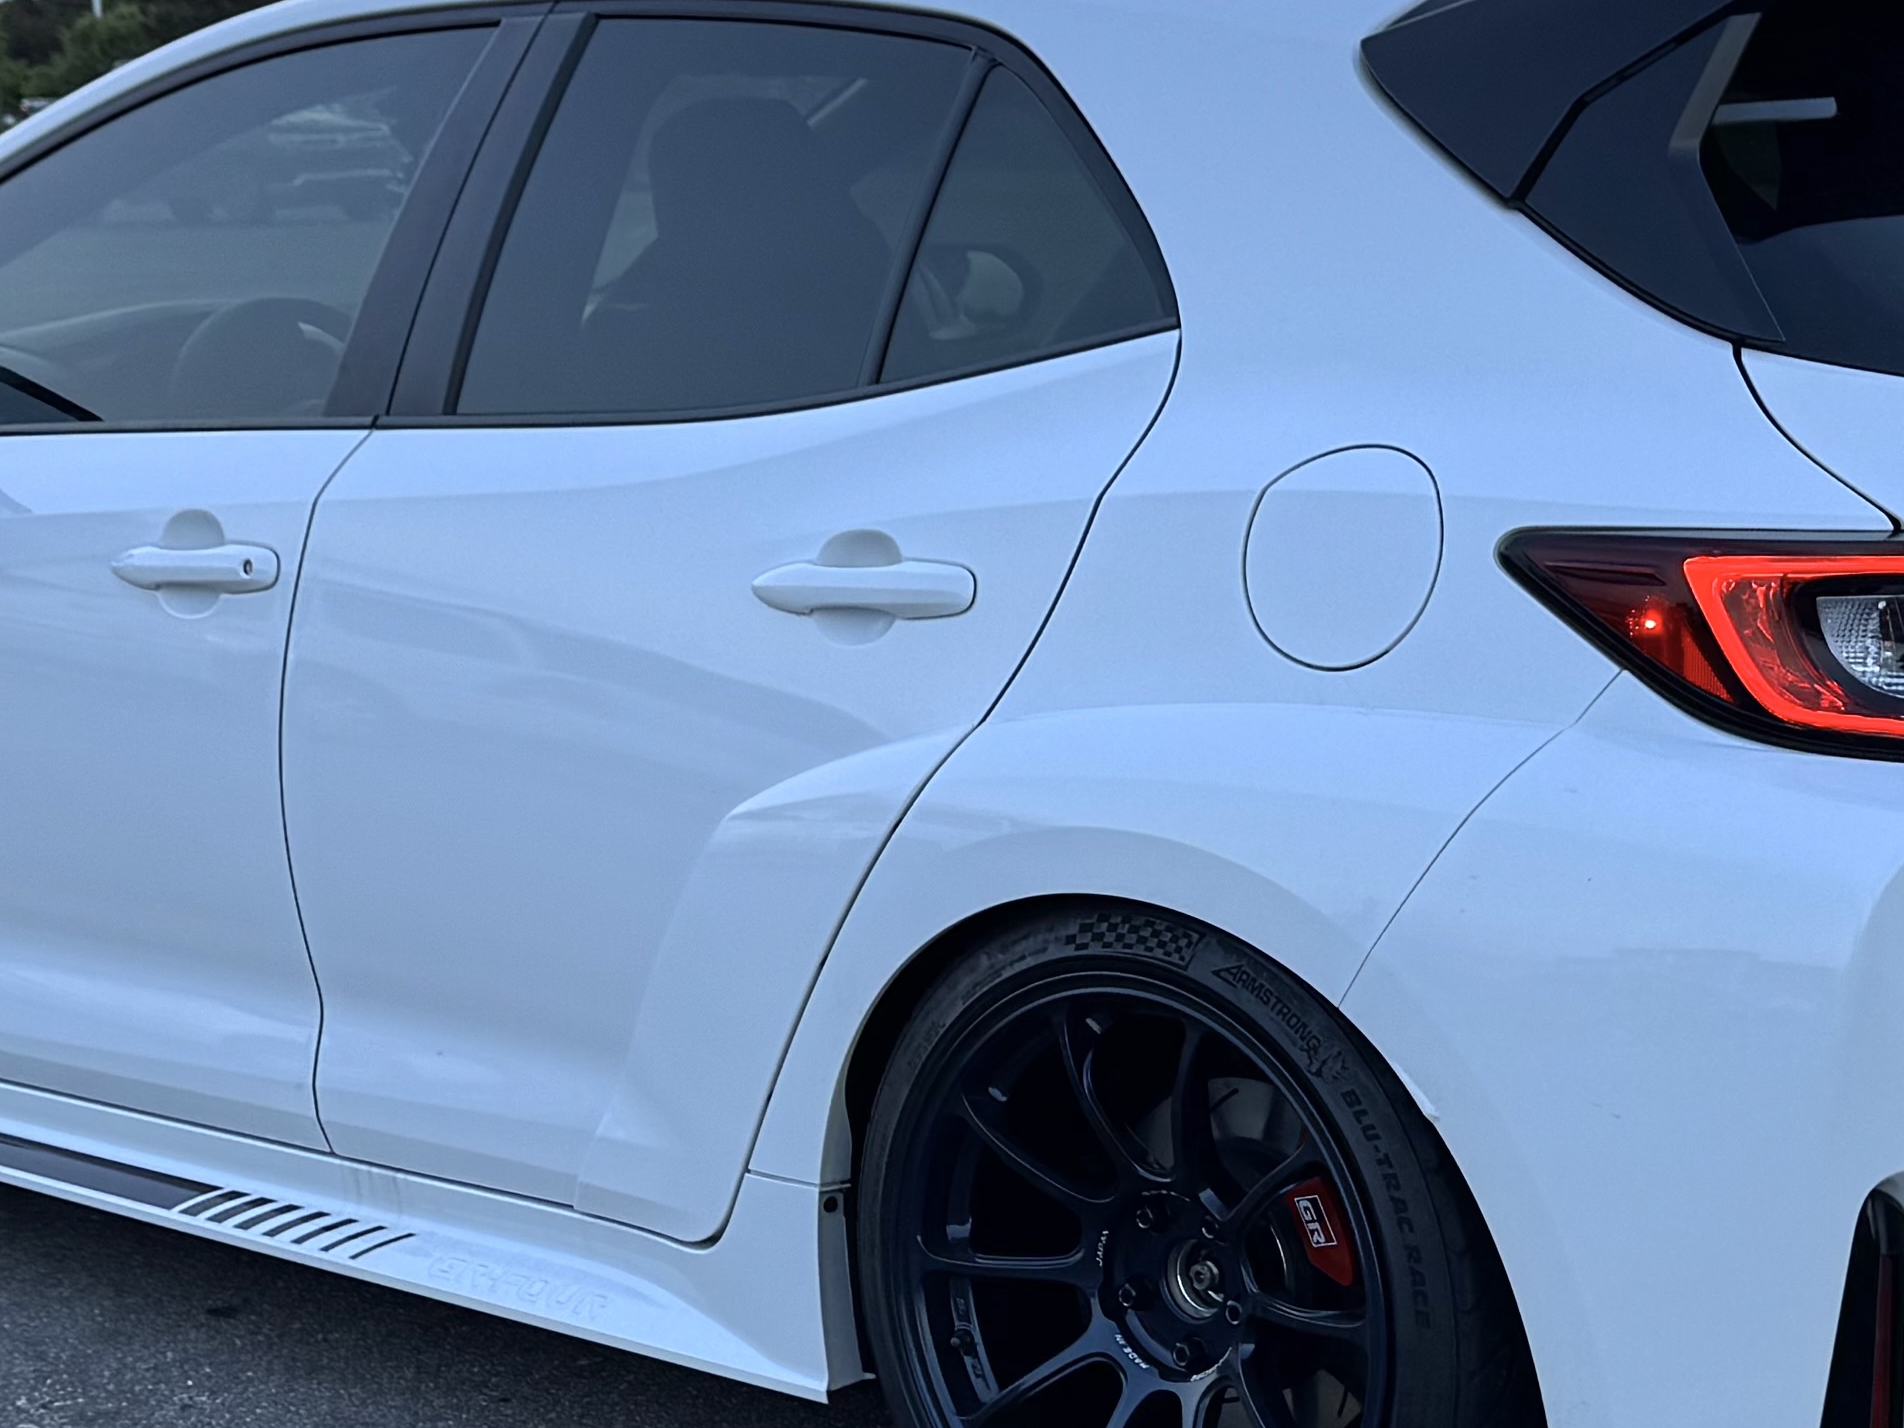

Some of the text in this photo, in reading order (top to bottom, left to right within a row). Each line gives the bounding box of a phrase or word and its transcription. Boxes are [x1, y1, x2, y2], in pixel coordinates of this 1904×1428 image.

[1211, 963, 1321, 1050] ARMSTRONG
[1299, 1199, 1326, 1243] GR
[1340, 1088, 1431, 1329] BLU-TRAC RACE
